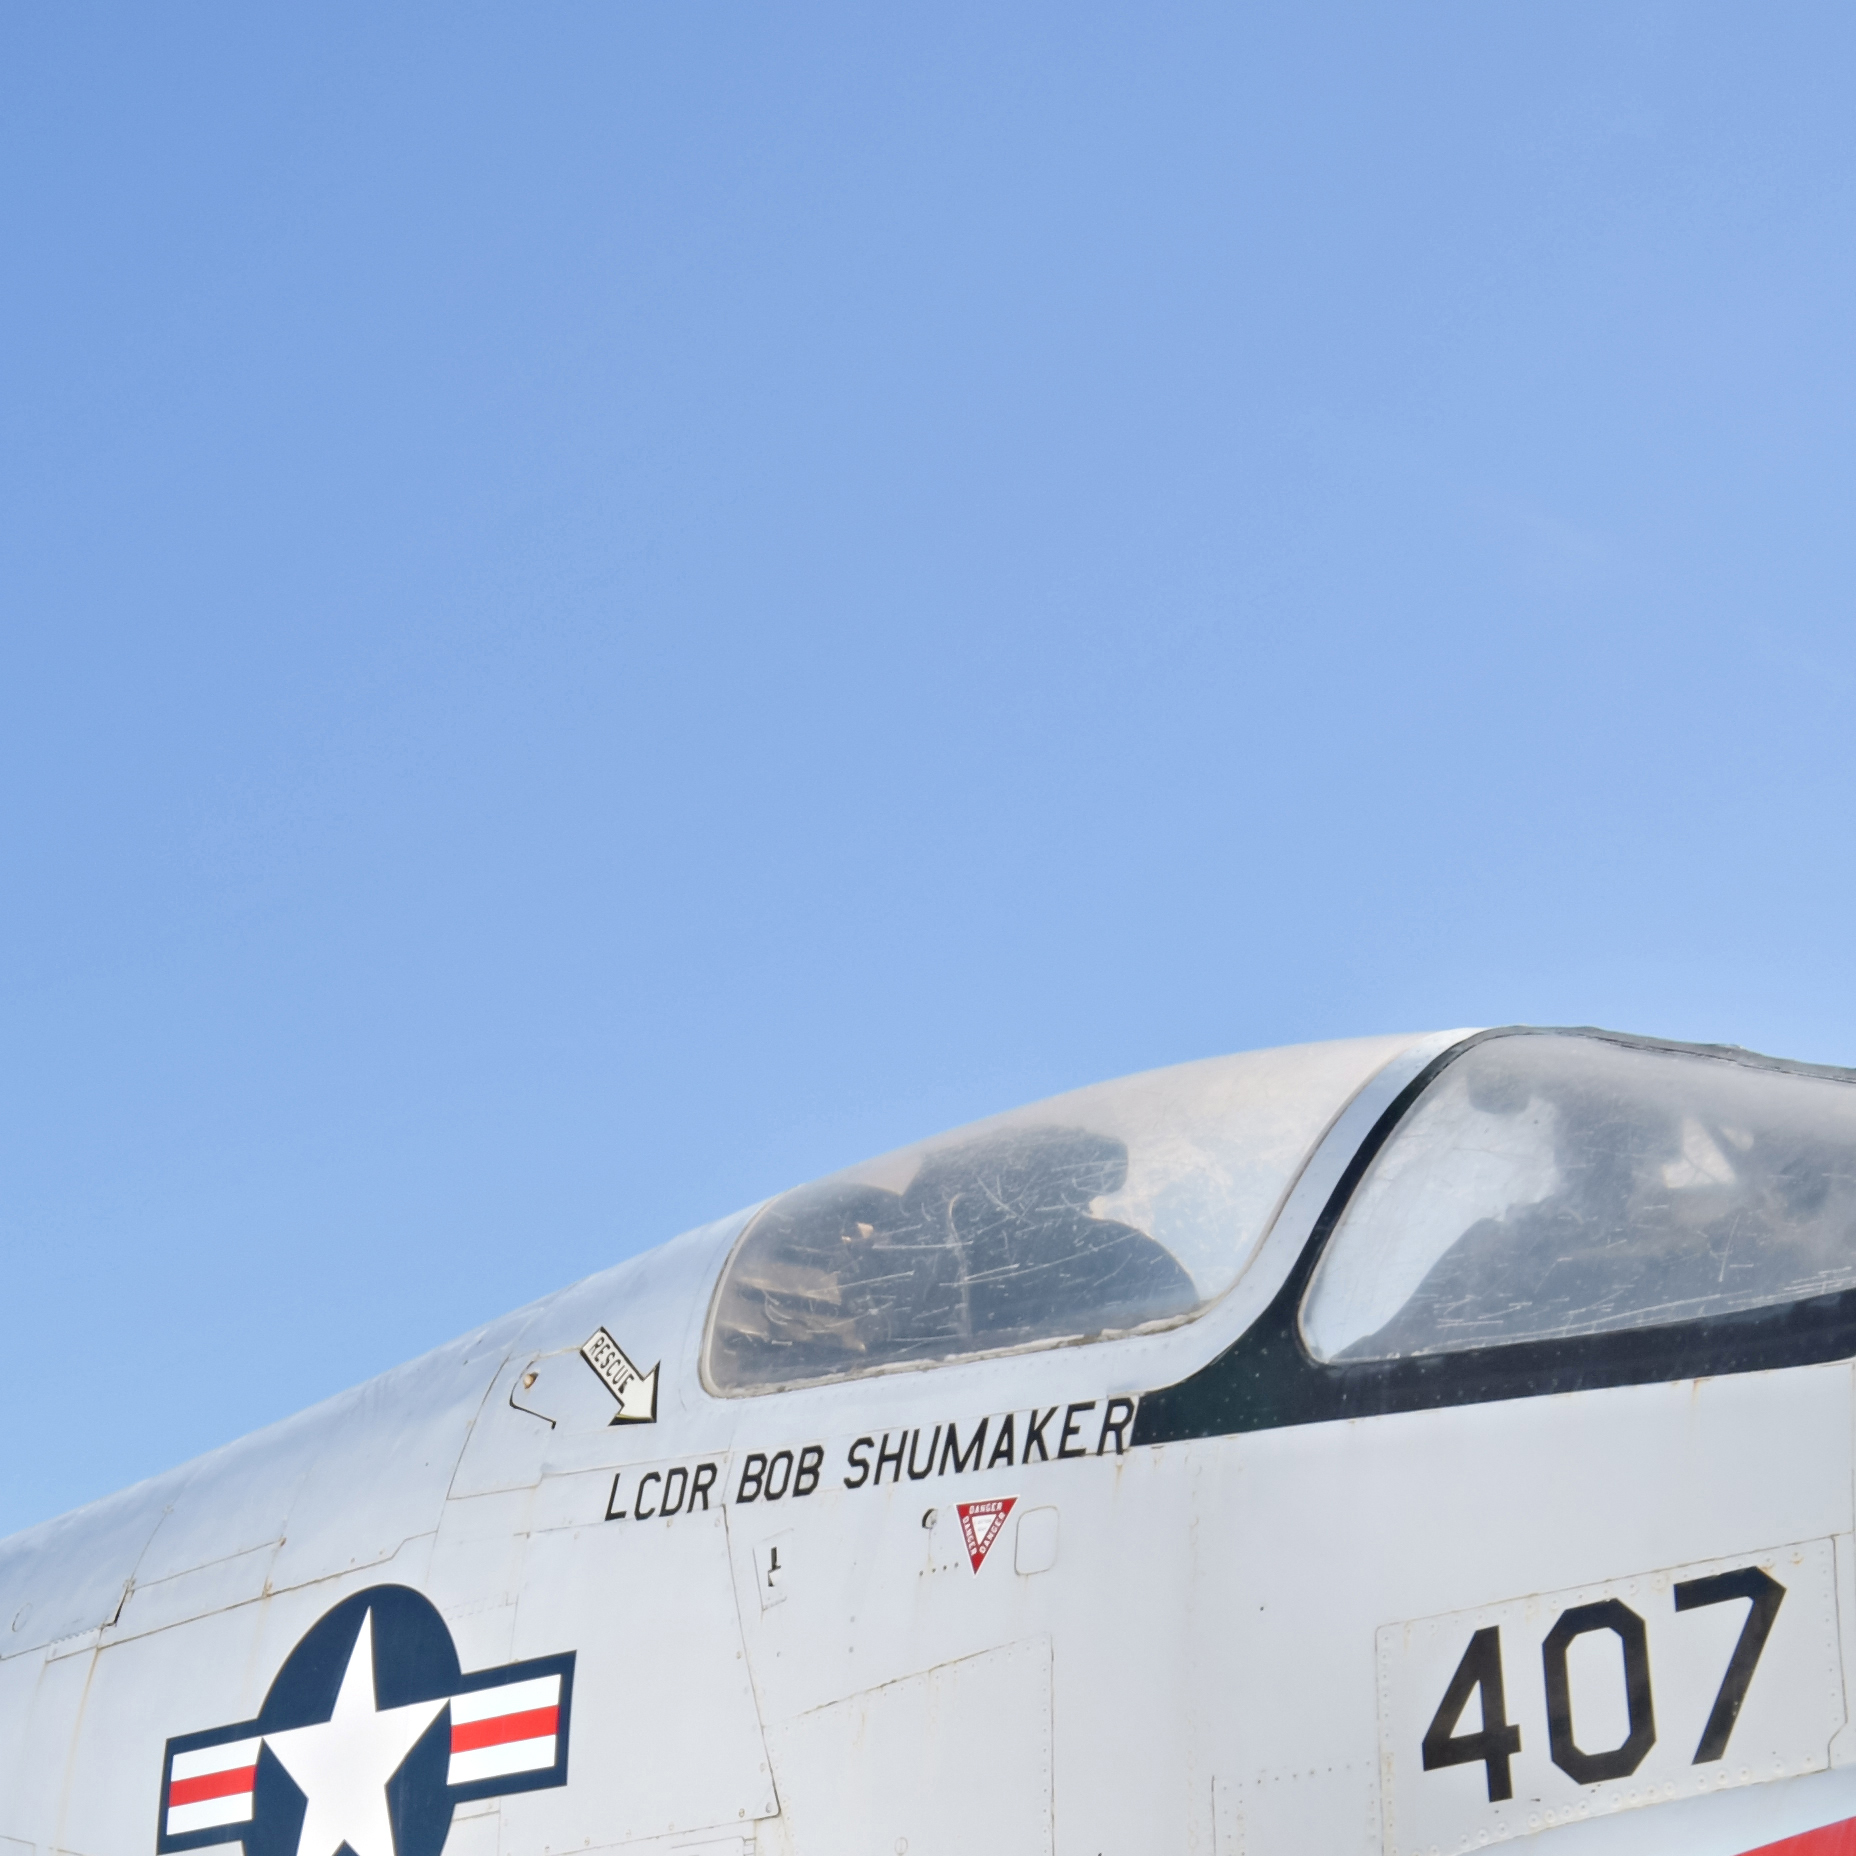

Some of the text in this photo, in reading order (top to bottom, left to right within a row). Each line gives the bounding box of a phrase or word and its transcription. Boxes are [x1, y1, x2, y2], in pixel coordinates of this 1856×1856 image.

[589, 1336, 635, 1395] RESCUE
[605, 1397, 1135, 1521] LCDR BOB SHUMAKER
[969, 1502, 1003, 1514] DANGER
[979, 1512, 1005, 1554] DANGER
[963, 1515, 977, 1556] DANGER
[1422, 1565, 1787, 1803] 407
